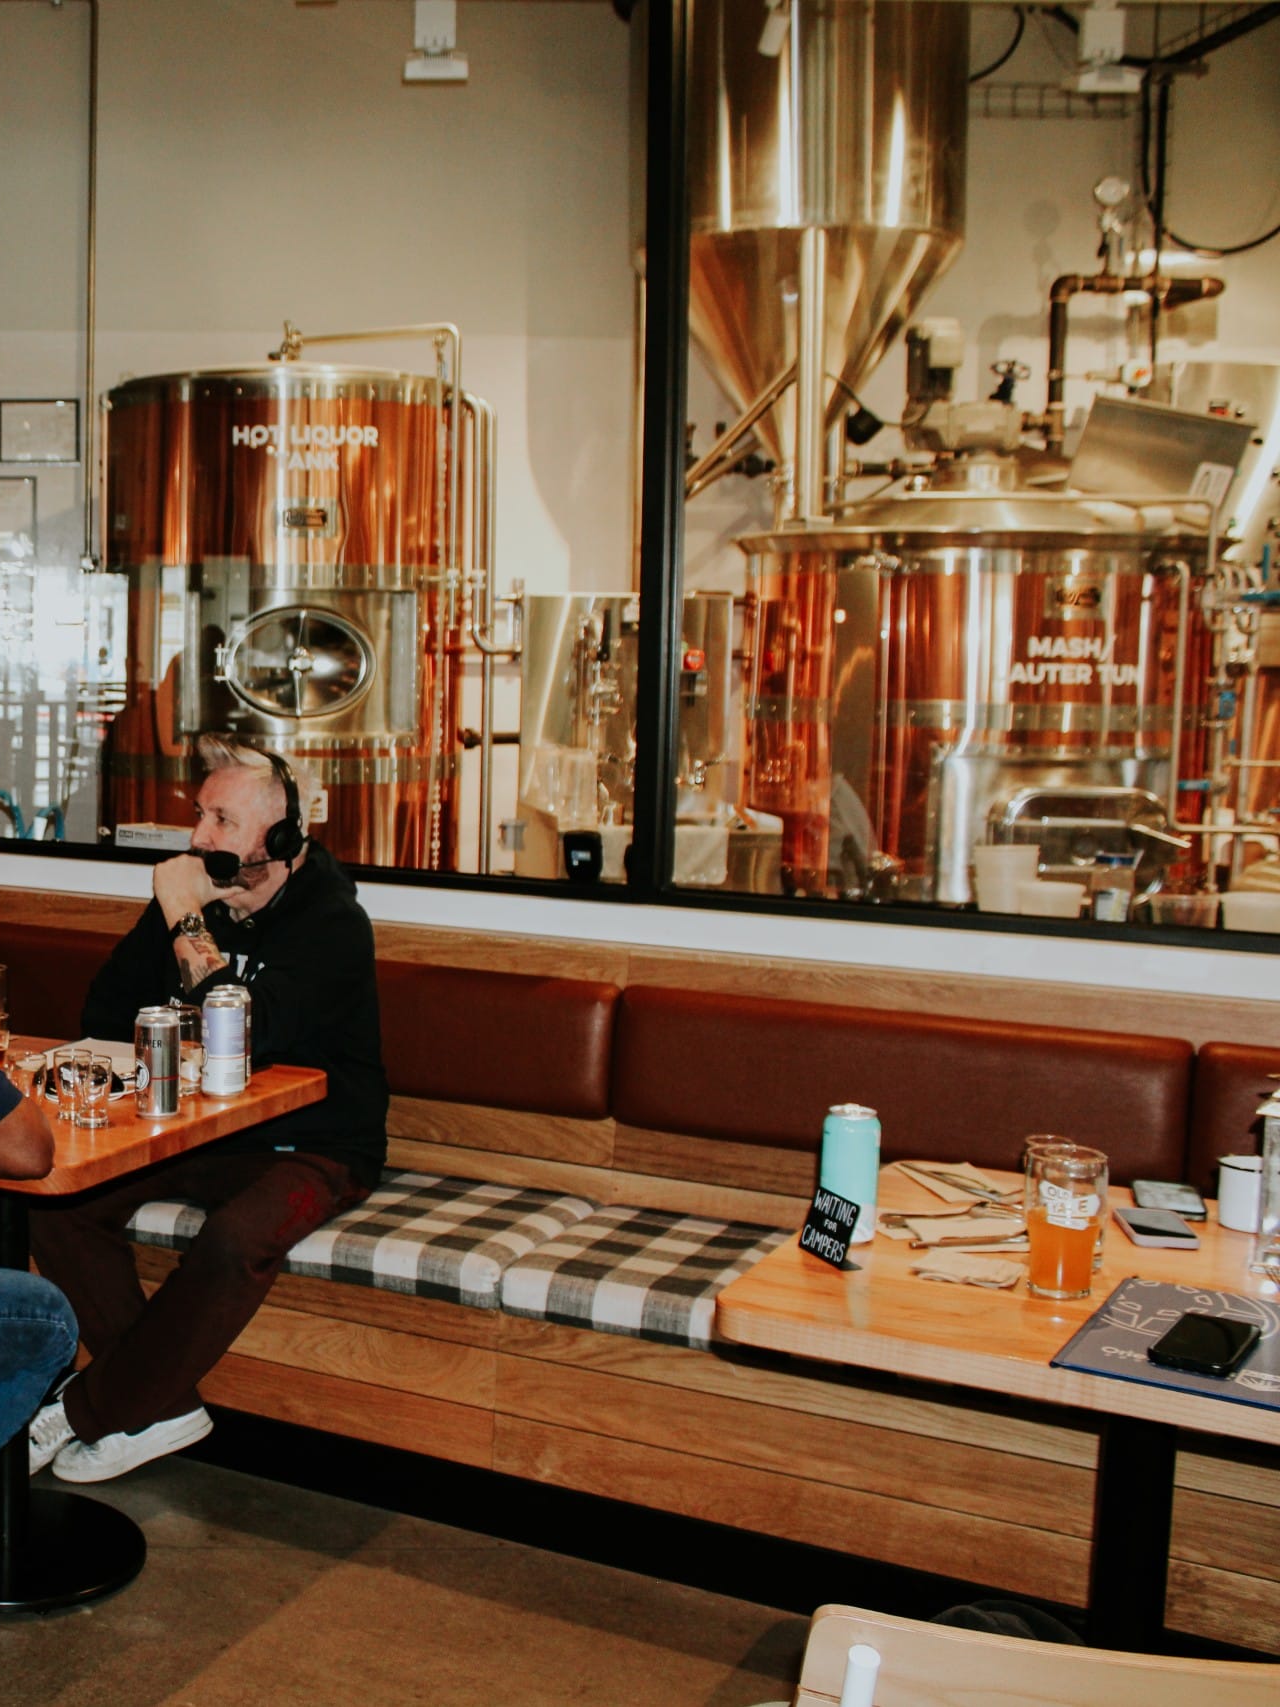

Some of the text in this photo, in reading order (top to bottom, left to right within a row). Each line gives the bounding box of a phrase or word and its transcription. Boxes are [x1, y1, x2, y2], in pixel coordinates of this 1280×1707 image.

[232, 424, 379, 448] HOT LIQUOR
[274, 450, 340, 471] TANK
[1027, 634, 1117, 661] MASH/
[1004, 661, 1093, 685] AUTER
[814, 1189, 857, 1227] WAITING
[823, 1218, 838, 1233] FOR
[801, 1224, 846, 1263] CAMPERS
